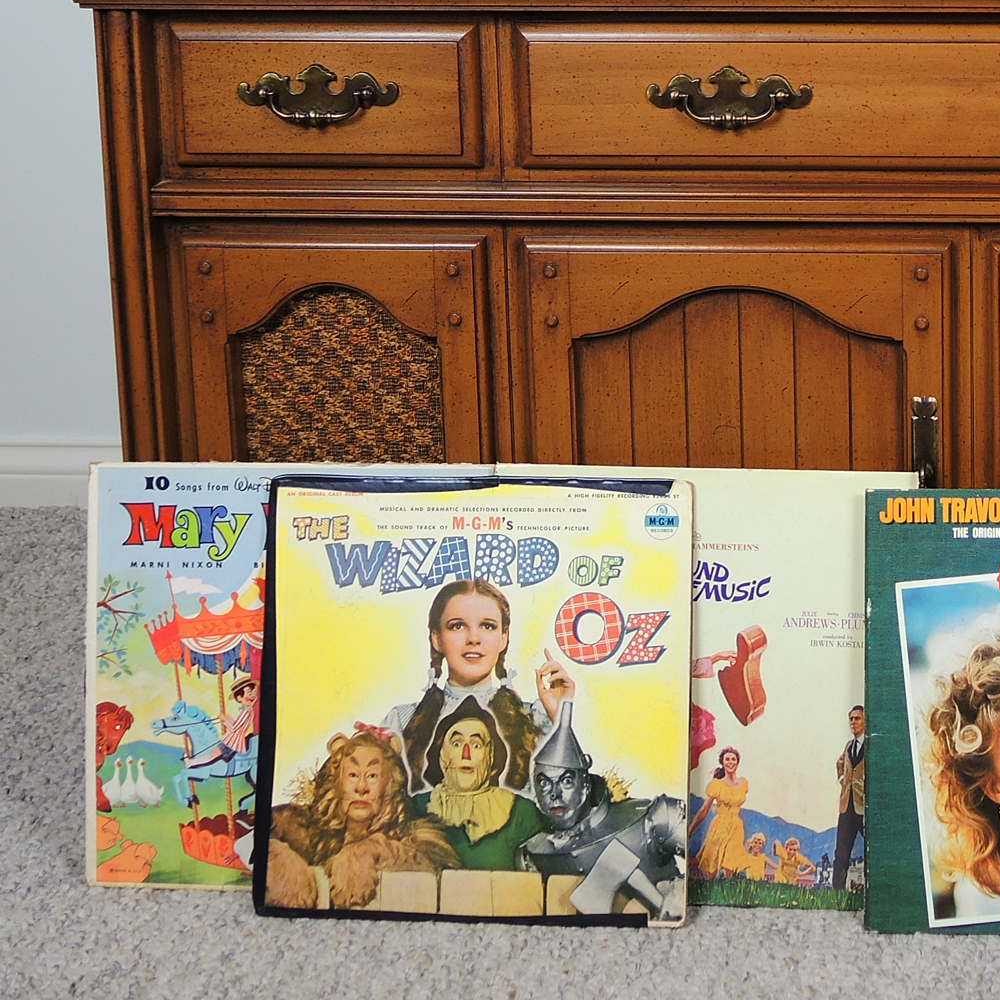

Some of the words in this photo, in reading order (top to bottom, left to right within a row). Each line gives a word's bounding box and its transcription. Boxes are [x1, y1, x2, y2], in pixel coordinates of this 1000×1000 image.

[144, 475, 170, 491] 10
[176, 482, 202, 493] Songs
[208, 482, 228, 491] from
[880, 498, 935, 524] JOHN
[119, 502, 254, 561] Mary
[293, 514, 350, 541] THE
[953, 527, 969, 539] THE
[130, 561, 170, 569] MARNI
[182, 561, 223, 569] NIXON
[324, 533, 559, 594] WIZARD
[567, 554, 625, 587] OF
[783, 617, 837, 629] ANDREWS
[810, 640, 834, 648] IRWIN
